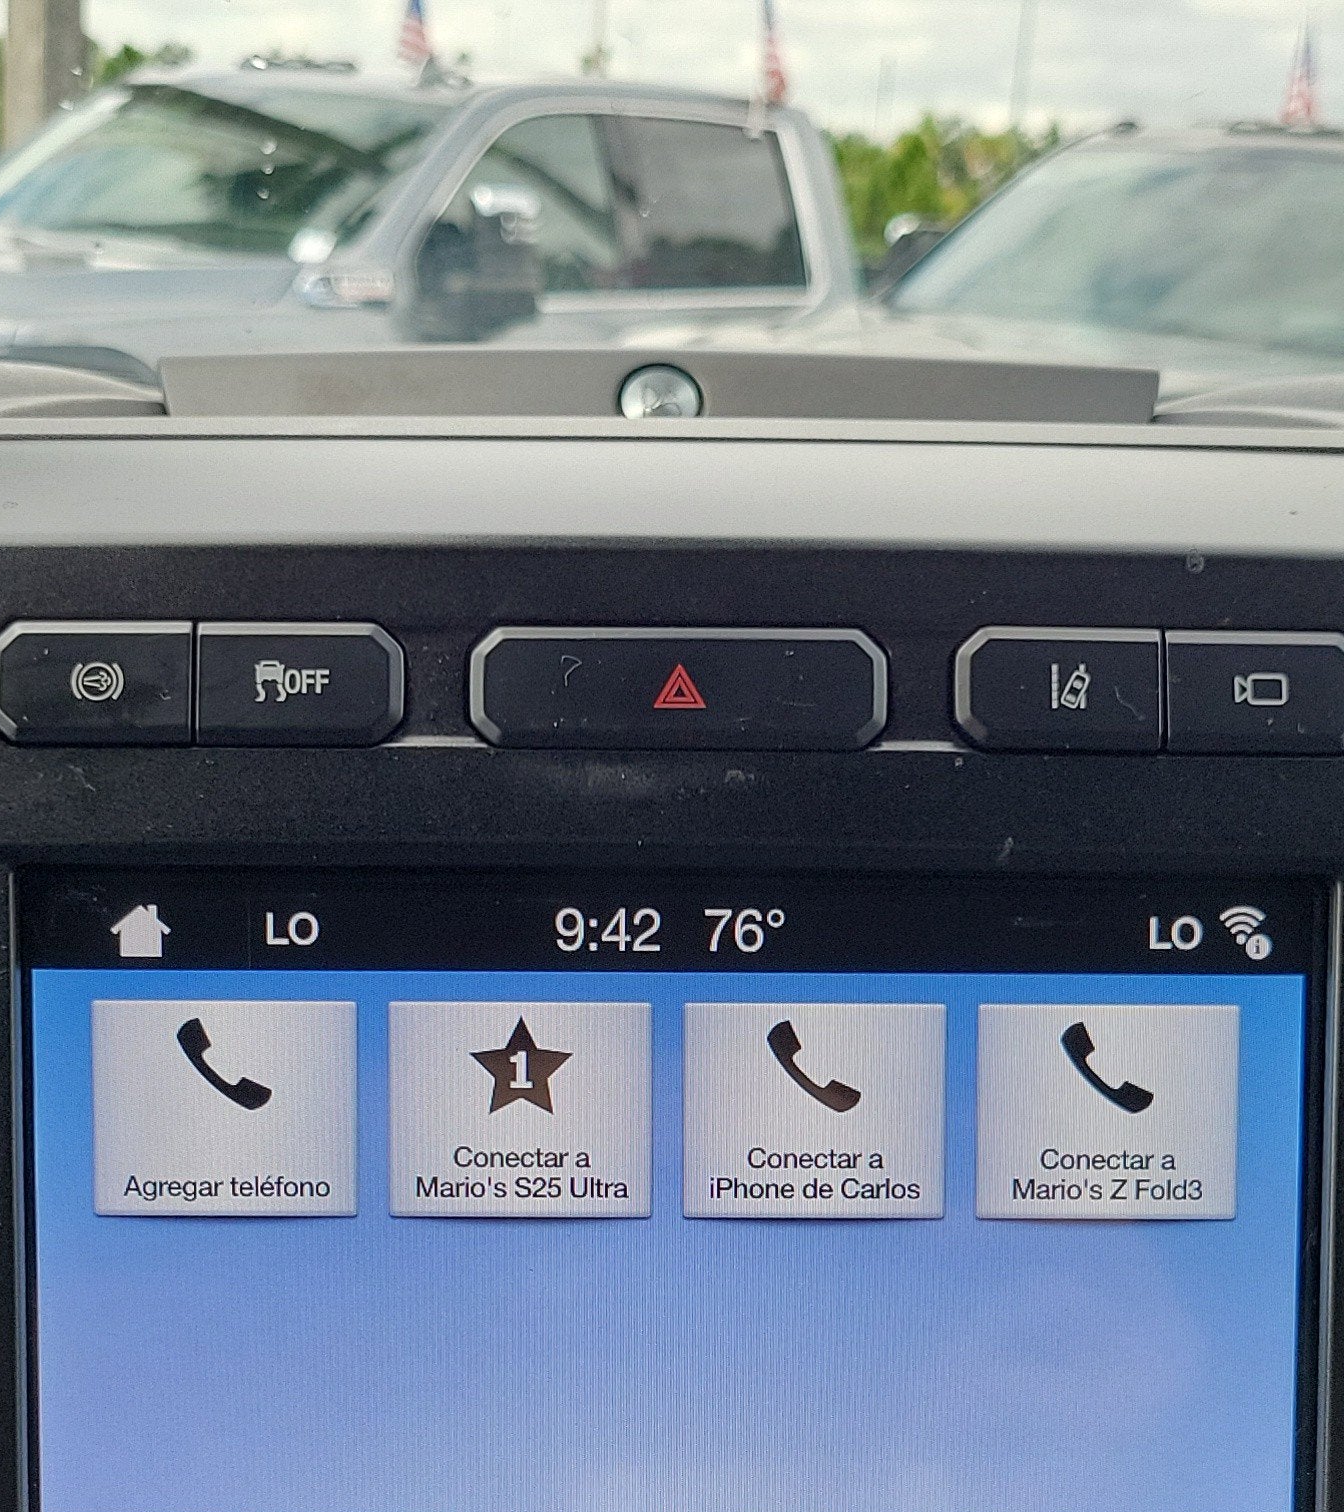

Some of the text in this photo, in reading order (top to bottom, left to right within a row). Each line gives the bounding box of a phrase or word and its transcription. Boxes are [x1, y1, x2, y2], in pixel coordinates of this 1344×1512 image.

[284, 669, 330, 694] OFF
[266, 911, 320, 946] LO
[555, 907, 661, 952] 9:42
[1149, 916, 1203, 951] LO
[509, 1050, 534, 1089] 1
[452, 1145, 592, 1169] Conectar a
[747, 1147, 884, 1170] Conectar a
[1039, 1148, 1177, 1171] Conectar a
[123, 1174, 331, 1202] Agregar teléfono
[415, 1175, 629, 1199] Mario's S25 Ultra
[710, 1176, 921, 1200] iPhone de Carlos
[1012, 1178, 1203, 1201] Mario's Z Fold3
